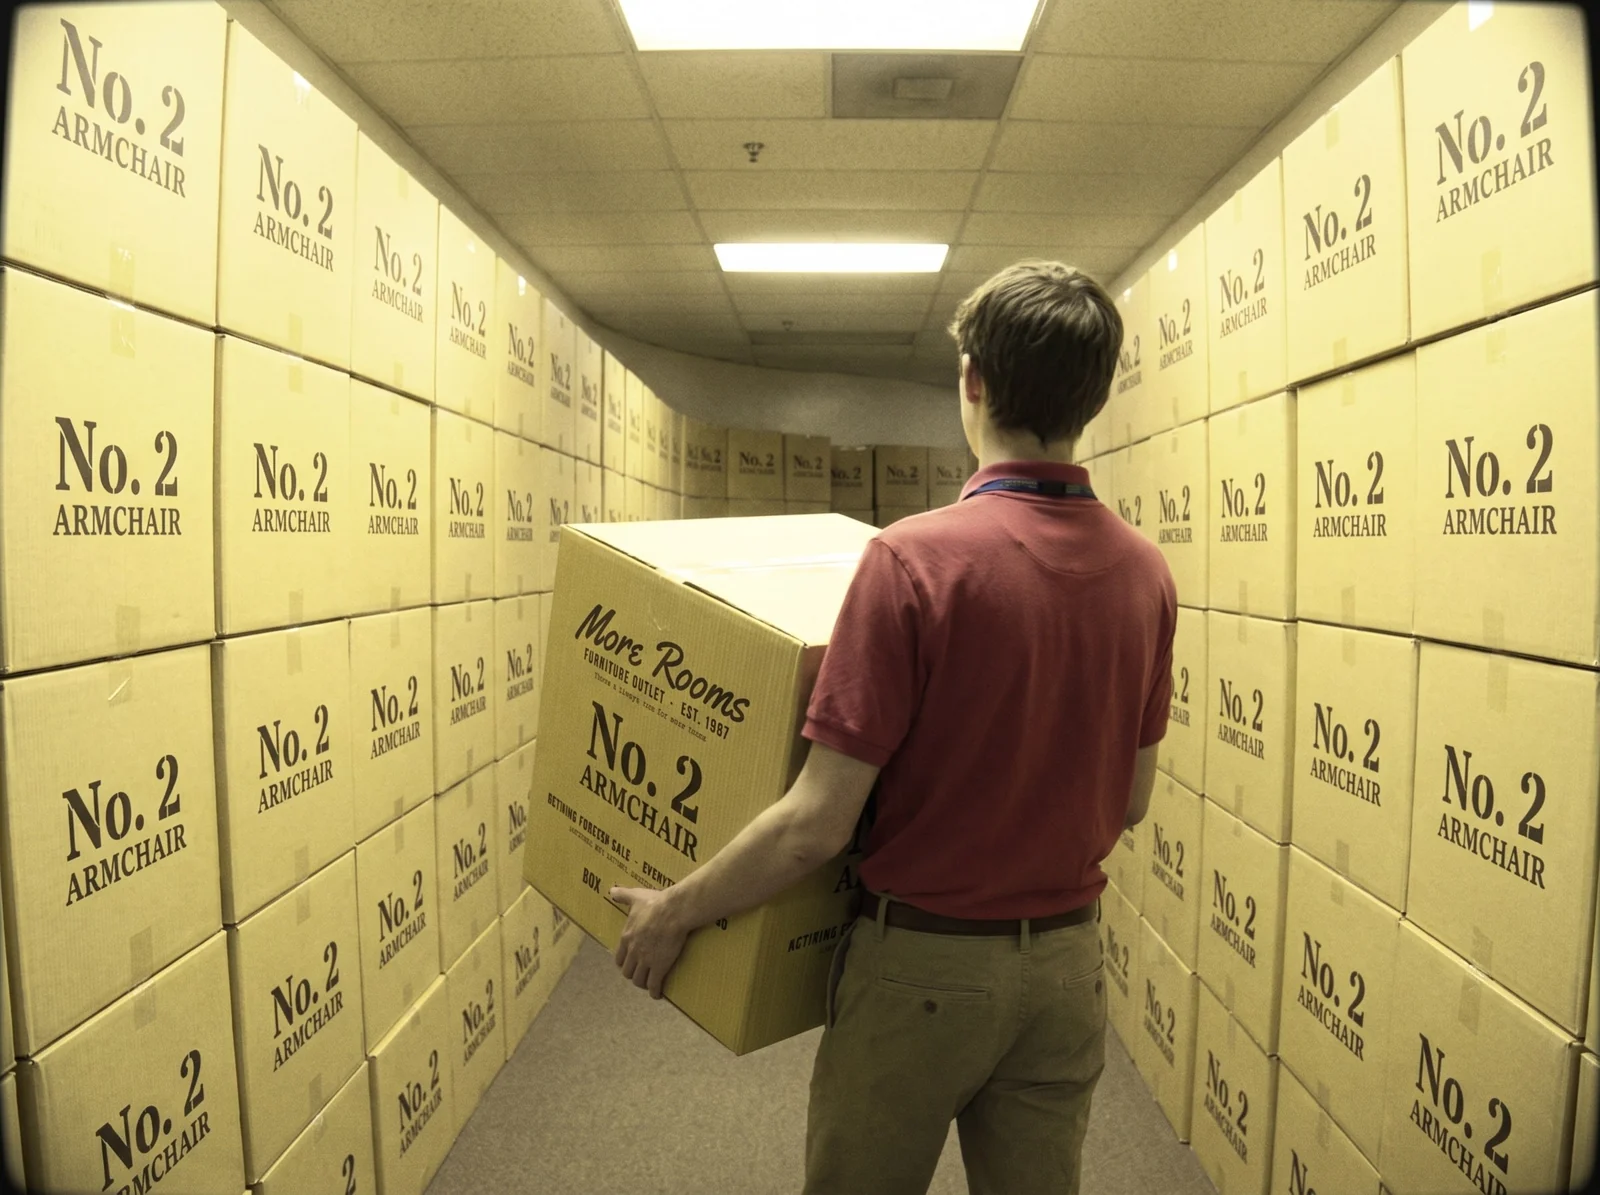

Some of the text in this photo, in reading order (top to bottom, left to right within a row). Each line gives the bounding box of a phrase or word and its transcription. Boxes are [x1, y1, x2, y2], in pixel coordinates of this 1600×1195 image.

[60, 18, 186, 158] No. 2
[1435, 60, 1548, 185] No. 2
[52, 106, 185, 198] ARMCHAIR
[1437, 138, 1554, 223] ARMCHAIR
[257, 144, 334, 240] No. 2
[1303, 174, 1372, 260] No. 2
[254, 212, 333, 272] ARMCHAIR
[374, 226, 422, 296] No. 2
[1304, 234, 1376, 290] ARMCHAIR
[372, 280, 423, 322] ARMCHAIR
[1220, 248, 1264, 314] No. 2
[452, 282, 486, 338] No. 2
[1158, 298, 1190, 350] No. 2
[1220, 297, 1267, 338] ARMCHAIR
[450, 326, 486, 360] ARMCHAIR
[508, 322, 534, 368] No. 2
[1134, 334, 1140, 368] 2
[55, 417, 178, 496] No. 2
[254, 443, 328, 502] No. 2
[1315, 450, 1384, 508] No. 2
[1446, 424, 1554, 498] No. 2
[370, 462, 416, 510] No. 2
[450, 478, 484, 518] No. 2
[508, 490, 532, 524] No. 2
[1134, 494, 1142, 526] 2
[1158, 486, 1190, 524] No. 2
[1222, 472, 1266, 518] No. 2
[53, 504, 181, 536] ARMCHAIR
[252, 509, 330, 532] ARMCHAIR
[368, 515, 418, 534] ARMCHAIR
[448, 522, 486, 538] ARMCHAIR
[1220, 523, 1267, 542] ARMCHAIR
[1314, 514, 1386, 537] ARMCHAIR
[1443, 505, 1557, 535] ARMCHAIR
[450, 656, 484, 702] No. 2
[506, 644, 532, 682] No. 2
[574, 604, 644, 666] More
[652, 641, 750, 723] Rooms
[1180, 666, 1189, 704] 2
[370, 676, 418, 732] No. 2
[450, 696, 486, 726] ARMCHAIR
[584, 648, 630, 684] FURNITURE
[632, 674, 666, 705] OUTLET
[680, 702, 700, 725] EST.
[705, 716, 730, 740] 1987
[1220, 678, 1246, 726] No.
[1252, 688, 1264, 732] 2
[257, 704, 330, 779] No. 2
[371, 721, 420, 759] ARMCHAIR
[587, 700, 702, 824] No. 2
[1218, 724, 1264, 760] ARMCHAIR
[1313, 703, 1380, 774] No. 2
[62, 754, 180, 861] No. 2
[258, 760, 333, 813] ARMCHAIR
[1311, 758, 1381, 807] ARMCHAIR
[1443, 745, 1546, 846] No. 2
[580, 765, 698, 862] ARMCHAIR
[66, 824, 186, 906] ARMCHAIR
[452, 822, 486, 880] No. 2
[611, 838, 631, 862] SALE
[1152, 822, 1172, 870] No.
[1176, 840, 1184, 878] 2
[1438, 813, 1545, 889] ARMCHAIR
[378, 870, 424, 942] No. 2
[582, 867, 602, 894] BOX
[1212, 870, 1256, 940] No. 2
[379, 912, 426, 969] ARMCHAIR
[1211, 914, 1255, 968] ARMCHAIR
[271, 942, 340, 1039] No. 2
[1300, 932, 1366, 1028] No. 2
[274, 991, 343, 1072] ARMCHAIR
[462, 978, 494, 1044] No. 2
[1298, 985, 1364, 1061] ARMCHAIR
[398, 1050, 440, 1134] No. 2
[1206, 1050, 1248, 1136] No. 2
[1416, 1033, 1512, 1176] No. 2
[95, 1050, 204, 1192] No. 2
[400, 1088, 442, 1158] ARMCHAIR
